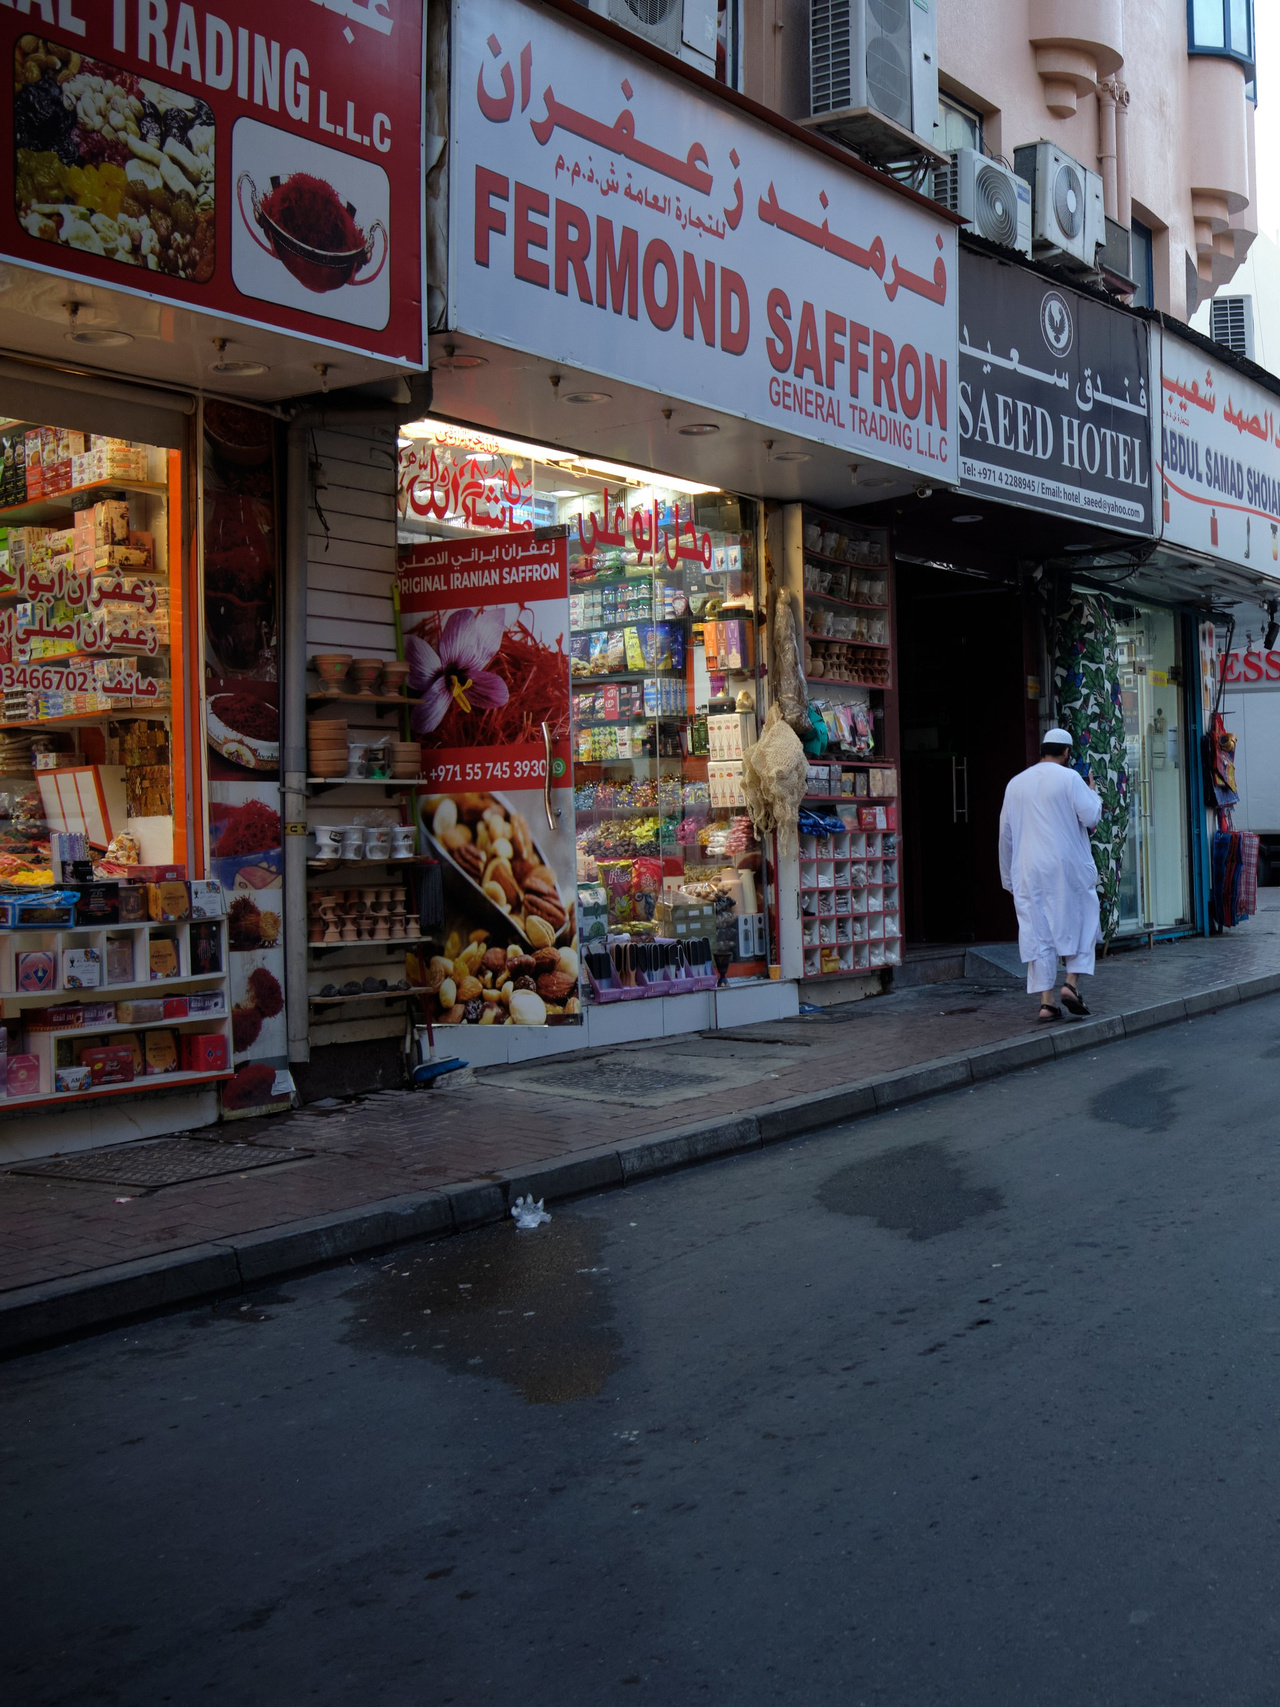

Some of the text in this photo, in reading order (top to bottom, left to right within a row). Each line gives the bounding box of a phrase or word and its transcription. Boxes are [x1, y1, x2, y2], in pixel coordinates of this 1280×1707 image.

[109, 0, 310, 123] TRADING
[319, 89, 392, 153] L.L.C
[476, 33, 947, 306] فرمند زعفران
[624, 171, 671, 216] العامة
[675, 196, 726, 240] للتجارة
[474, 164, 750, 356] FERMOND
[765, 287, 948, 431] SAFFRON
[958, 324, 1069, 390] سعيد
[1075, 367, 1148, 417] فندق
[768, 376, 949, 463] GENERAL TRADING L.L.C
[958, 380, 1149, 489] SAEED HOTEL
[962, 461, 976, 477] Tel:
[978, 469, 996, 482] +971
[998, 471, 1003, 484] 4
[1004, 473, 1036, 493] 2288945
[1041, 483, 1062, 499] Email:
[1163, 425, 1203, 483] ABDUL
[1205, 447, 1244, 500] SAMAD
[578, 487, 712, 570] محل ابو علي
[397, 539, 556, 576] زعفران ايراني الاصلي
[450, 569, 500, 590] IRANIAN
[502, 562, 560, 585] SAFFRON
[66, 568, 157, 614] زعفران
[15, 614, 82, 655] اصلي
[84, 619, 158, 654] زعفران
[0, 666, 89, 692] 3466702
[430, 764, 462, 782] +971
[465, 763, 482, 780] 55
[485, 762, 510, 779] 745
[513, 760, 547, 778] 3930
